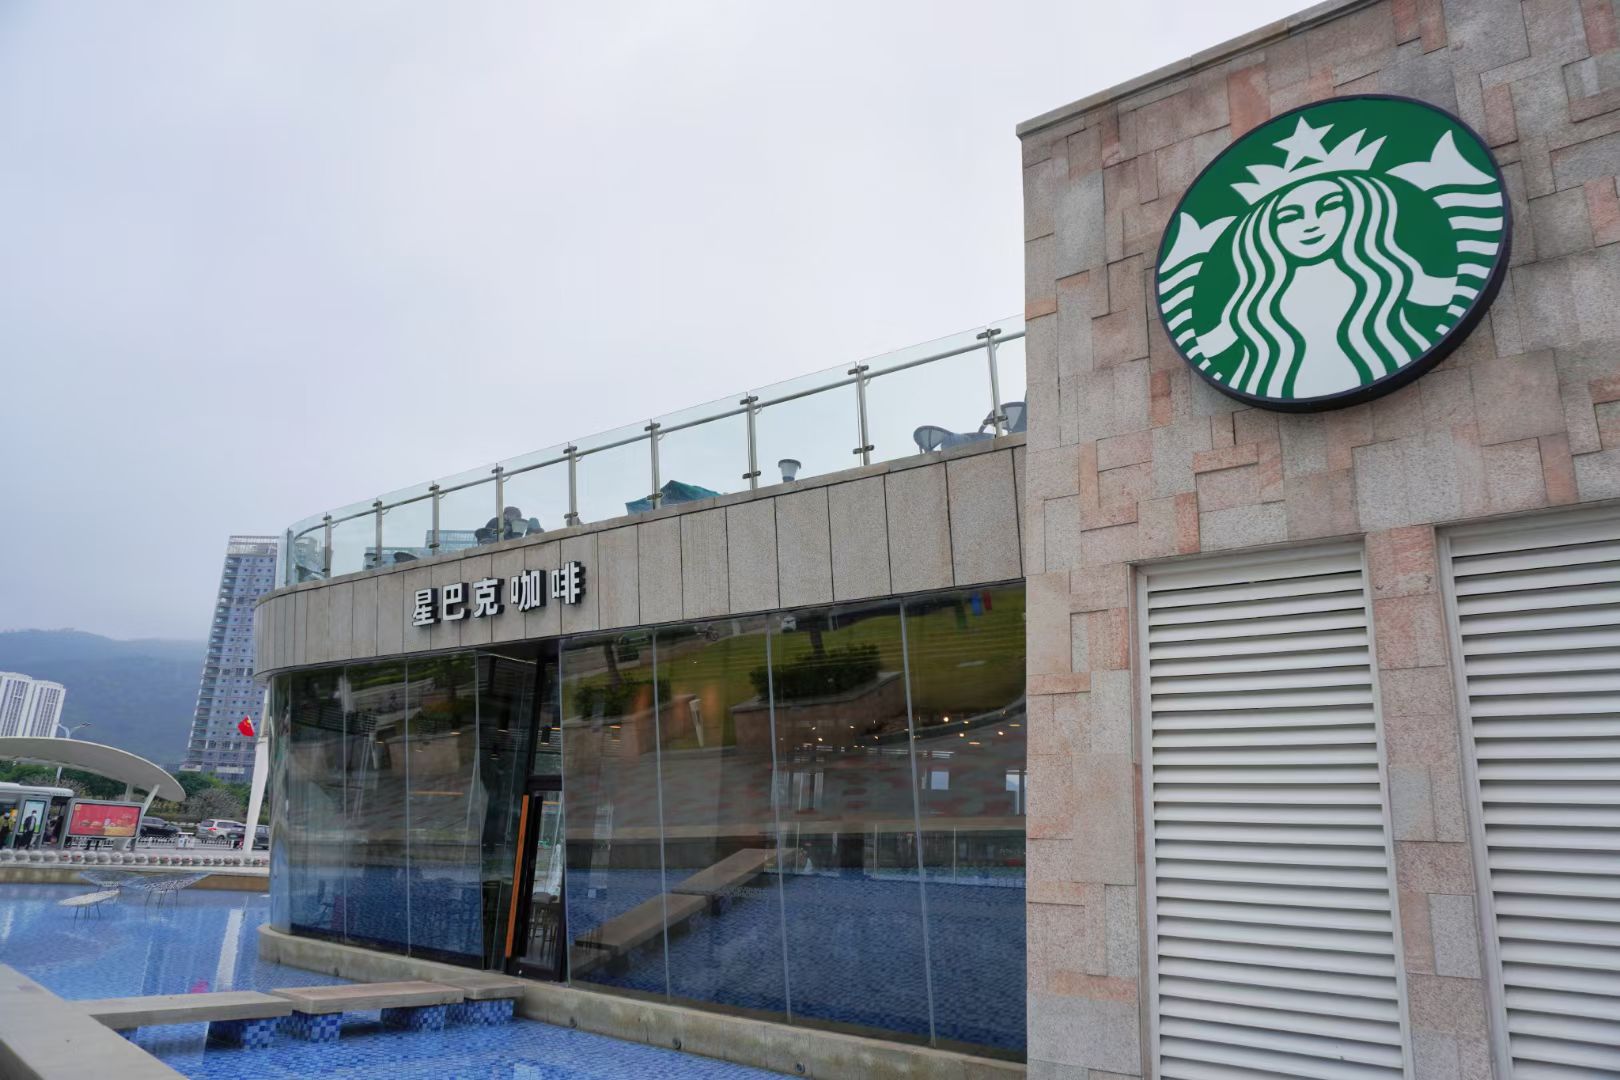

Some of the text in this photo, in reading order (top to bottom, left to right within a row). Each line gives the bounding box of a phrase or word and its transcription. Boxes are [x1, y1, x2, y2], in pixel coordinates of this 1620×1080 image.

[412, 561, 584, 627] 星巴克咖啡
